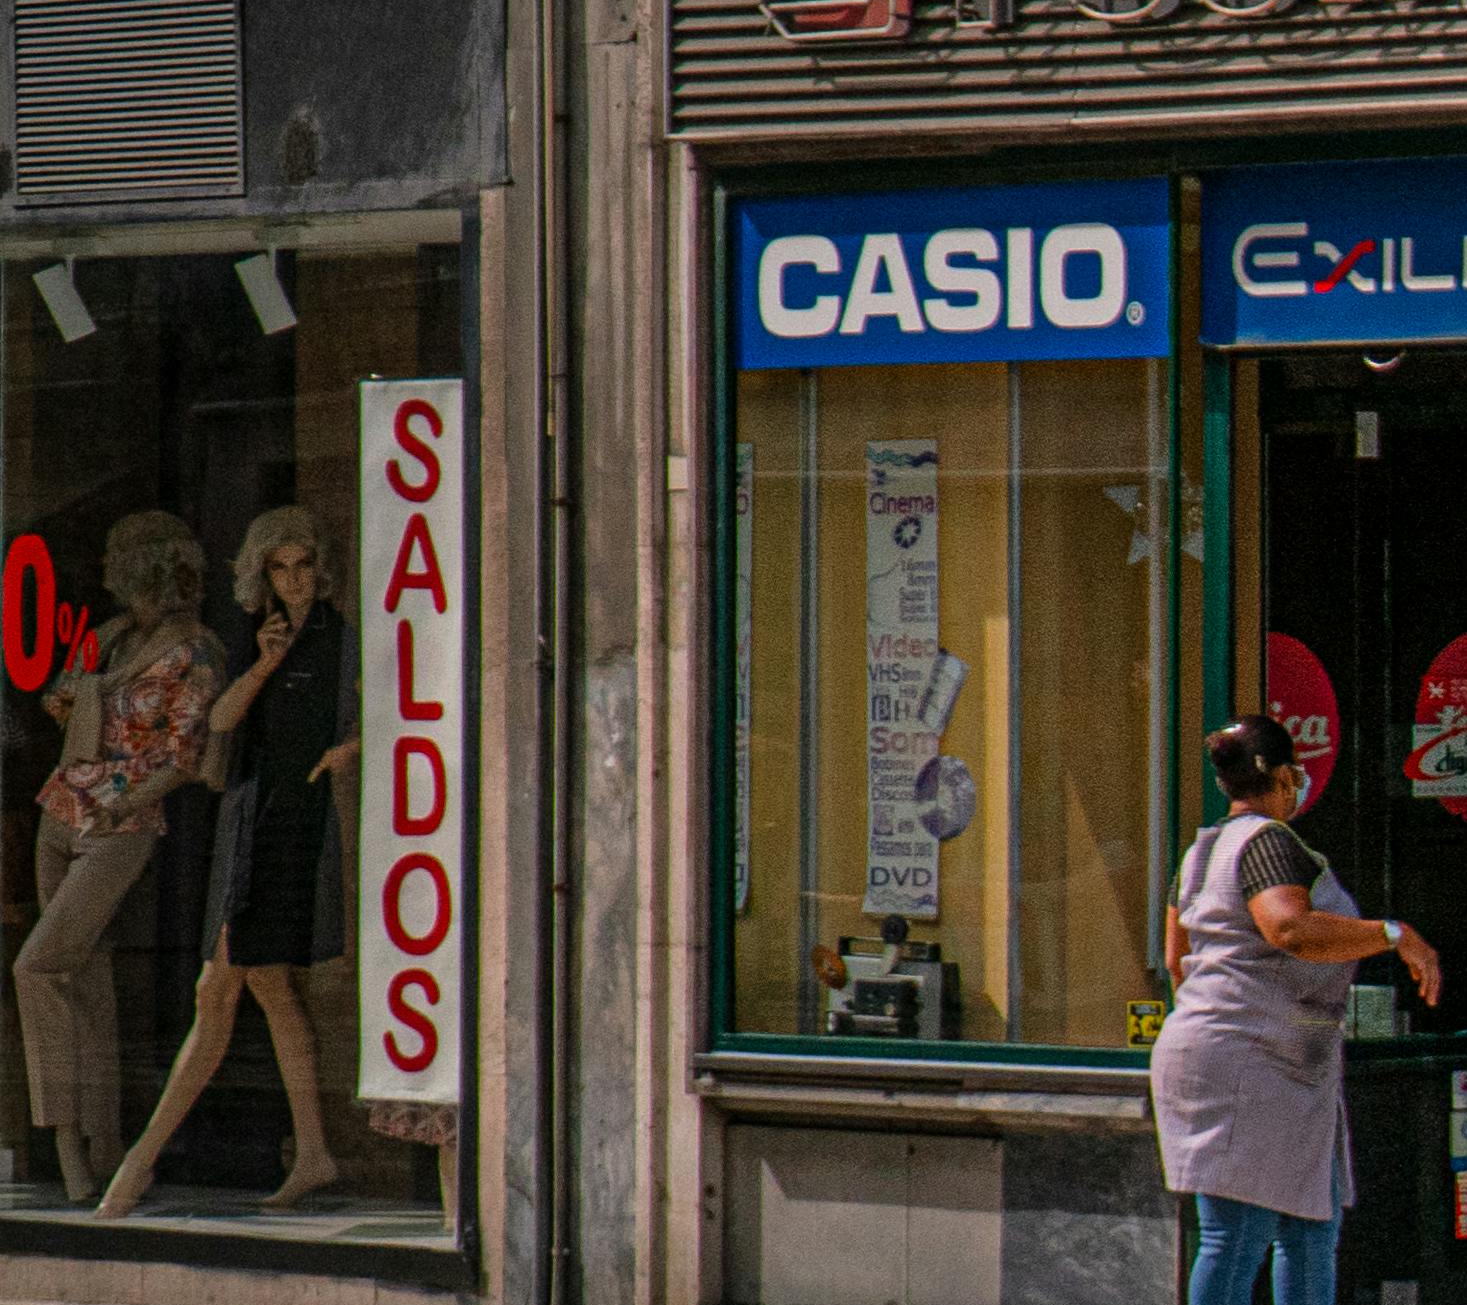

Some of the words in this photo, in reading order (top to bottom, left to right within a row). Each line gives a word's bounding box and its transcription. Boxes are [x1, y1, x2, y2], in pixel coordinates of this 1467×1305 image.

[758, 221, 1128, 341] CASIO
[382, 399, 450, 1073] SALDOS
[870, 866, 933, 887] DVD
